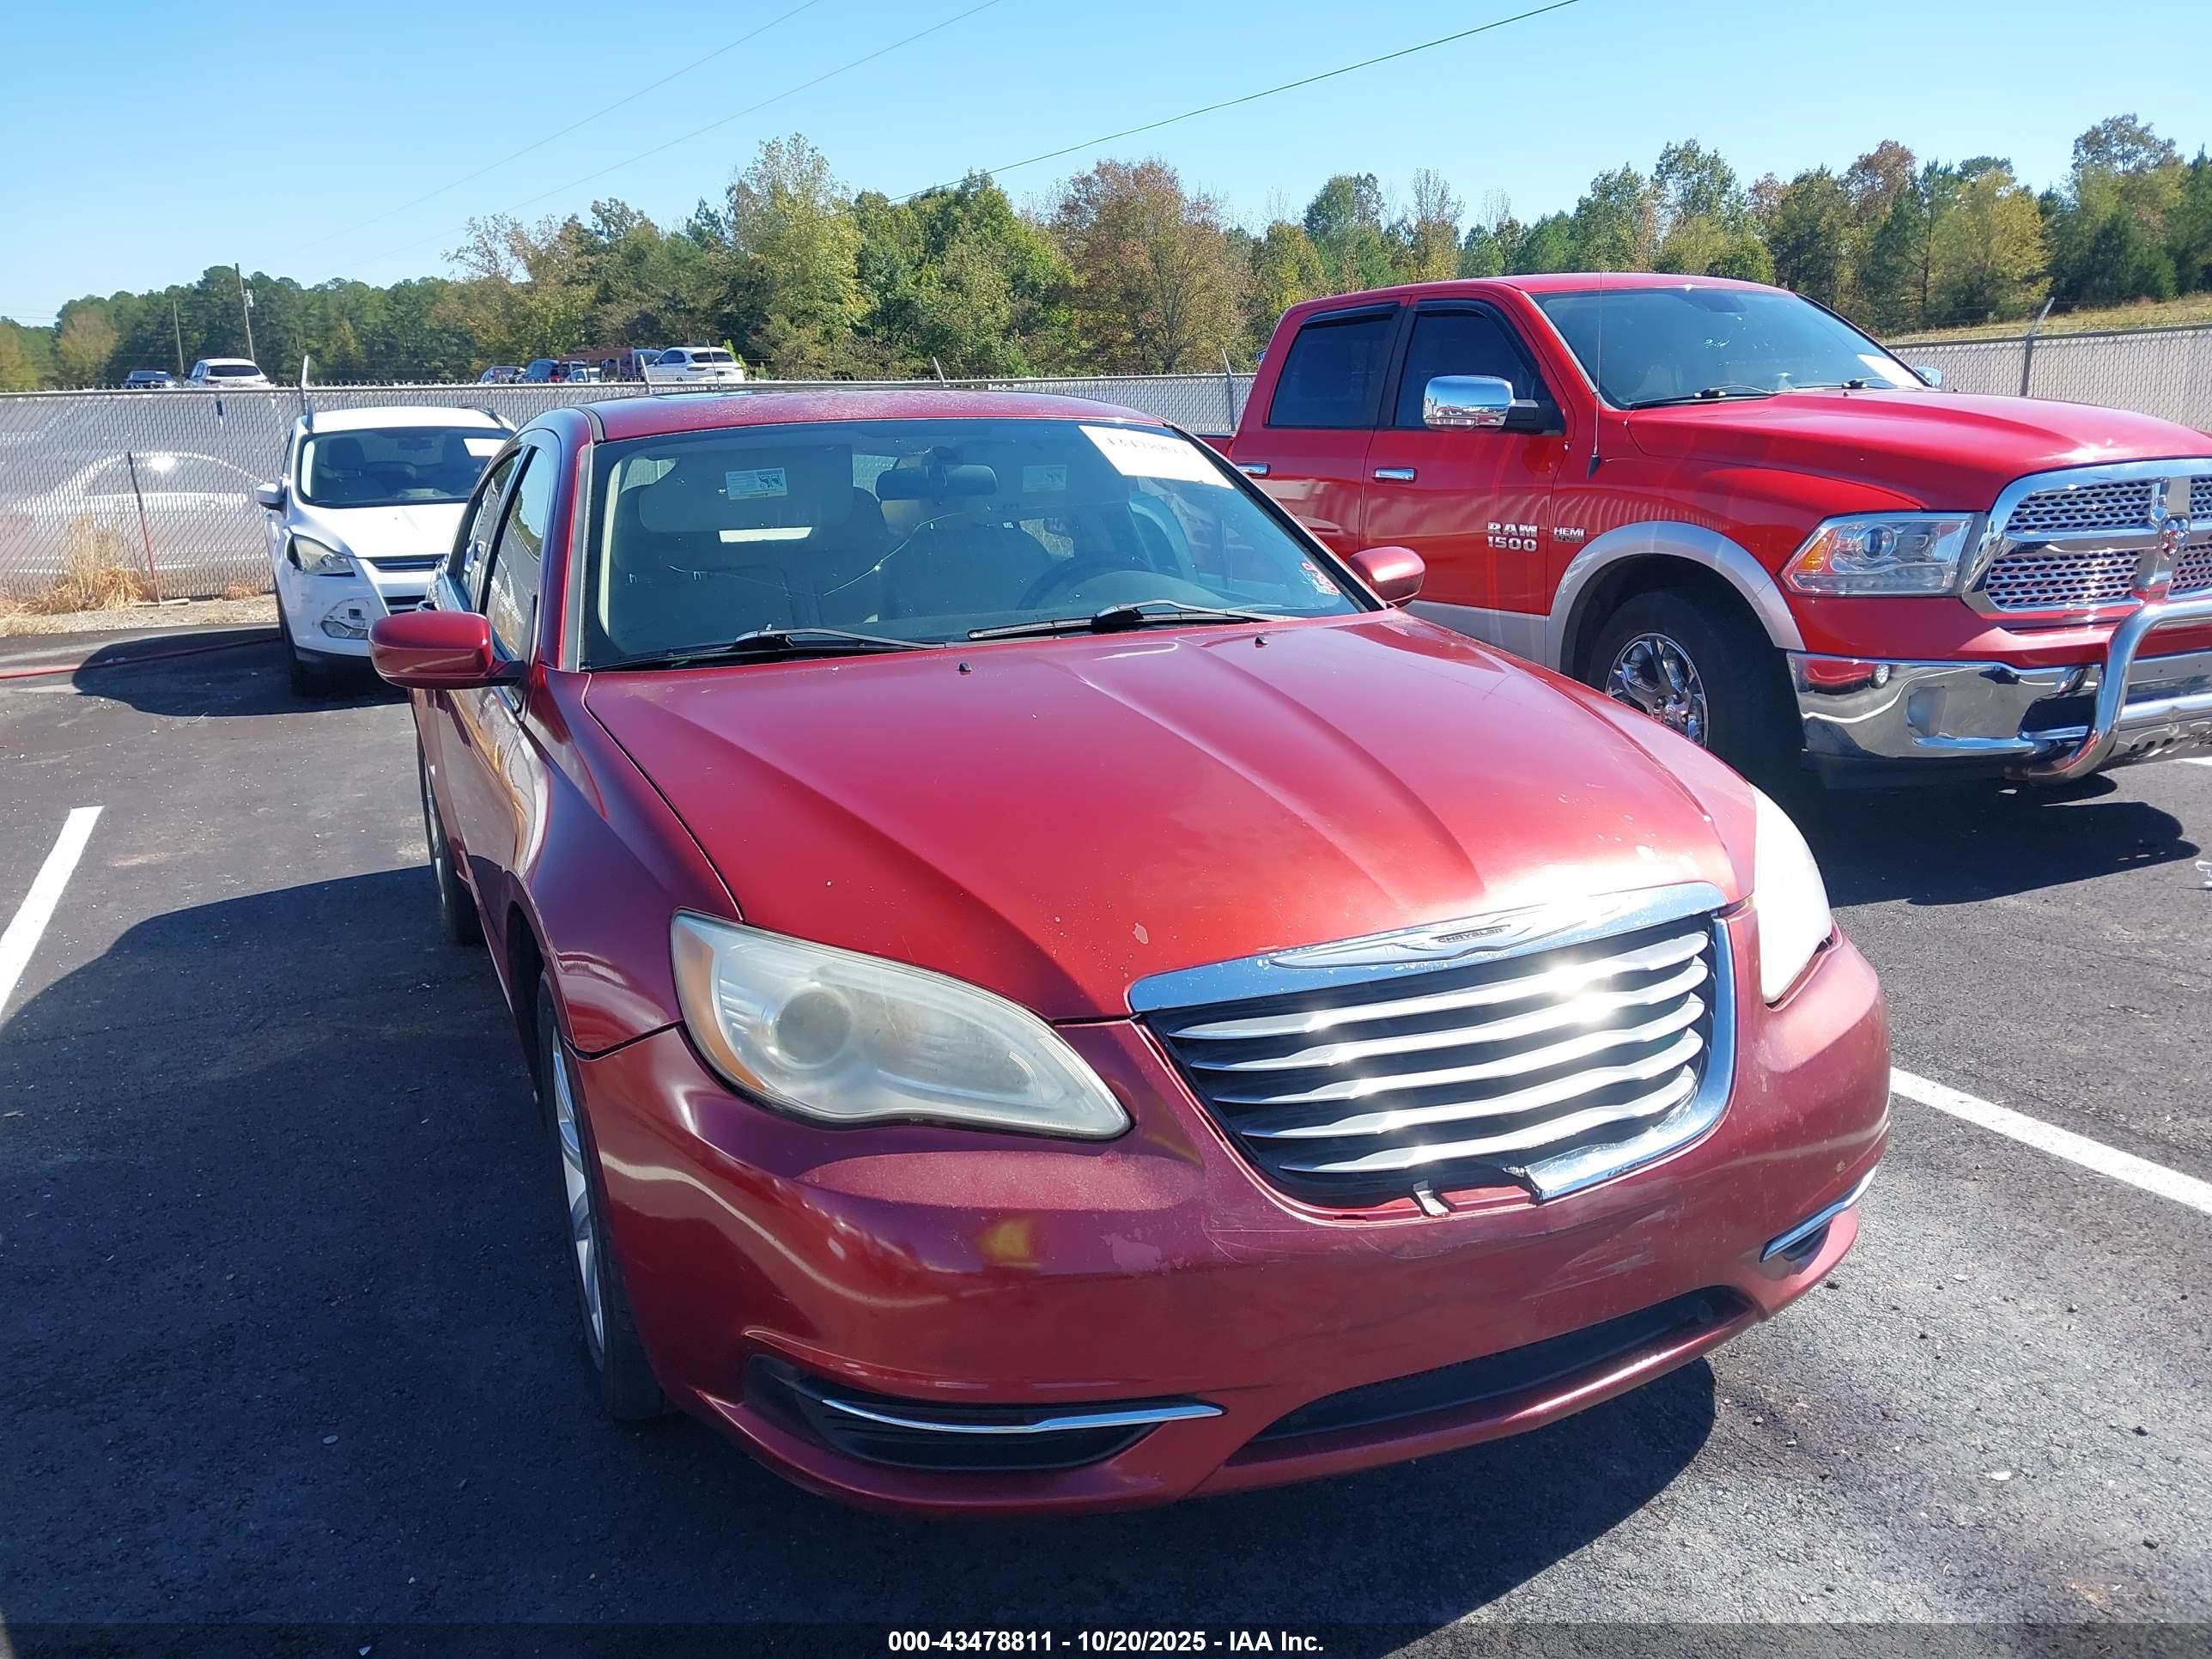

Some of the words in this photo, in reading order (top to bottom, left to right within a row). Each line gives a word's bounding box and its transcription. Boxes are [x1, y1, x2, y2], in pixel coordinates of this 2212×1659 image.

[1487, 521, 1538, 538] RAM
[1553, 526, 1585, 537] HEMI
[1487, 536, 1537, 552] 1500
[1437, 927, 1505, 944] CHRYSLER
